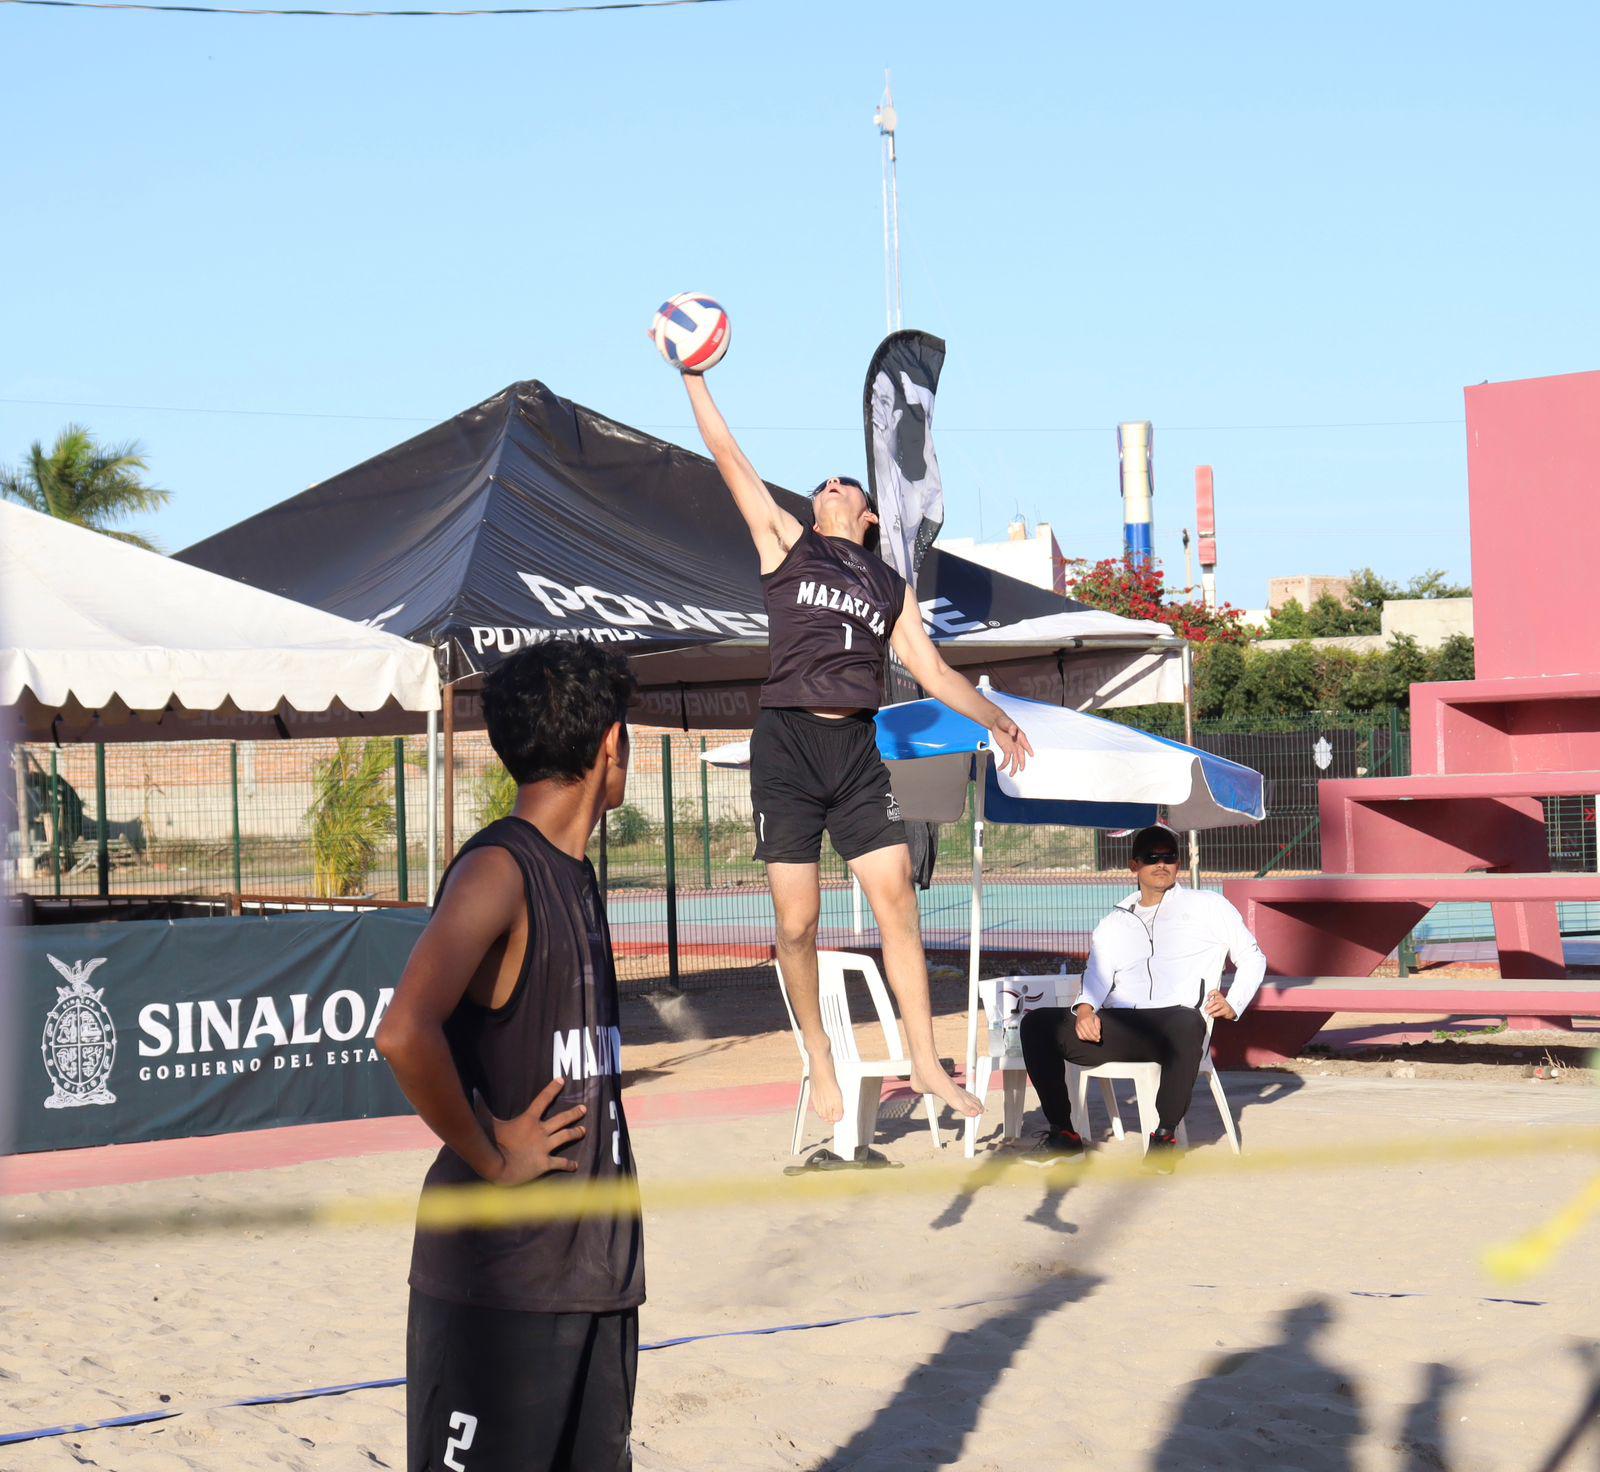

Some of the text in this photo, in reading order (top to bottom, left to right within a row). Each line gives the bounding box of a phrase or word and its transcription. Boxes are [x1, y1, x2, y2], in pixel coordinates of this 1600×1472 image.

[842, 622, 853, 650] 1
[759, 812, 765, 842] 1
[139, 988, 395, 1057] SINALOA
[139, 1048, 387, 1081] GOBIERNO DEL ESTA
[443, 1410, 478, 1472] 2
